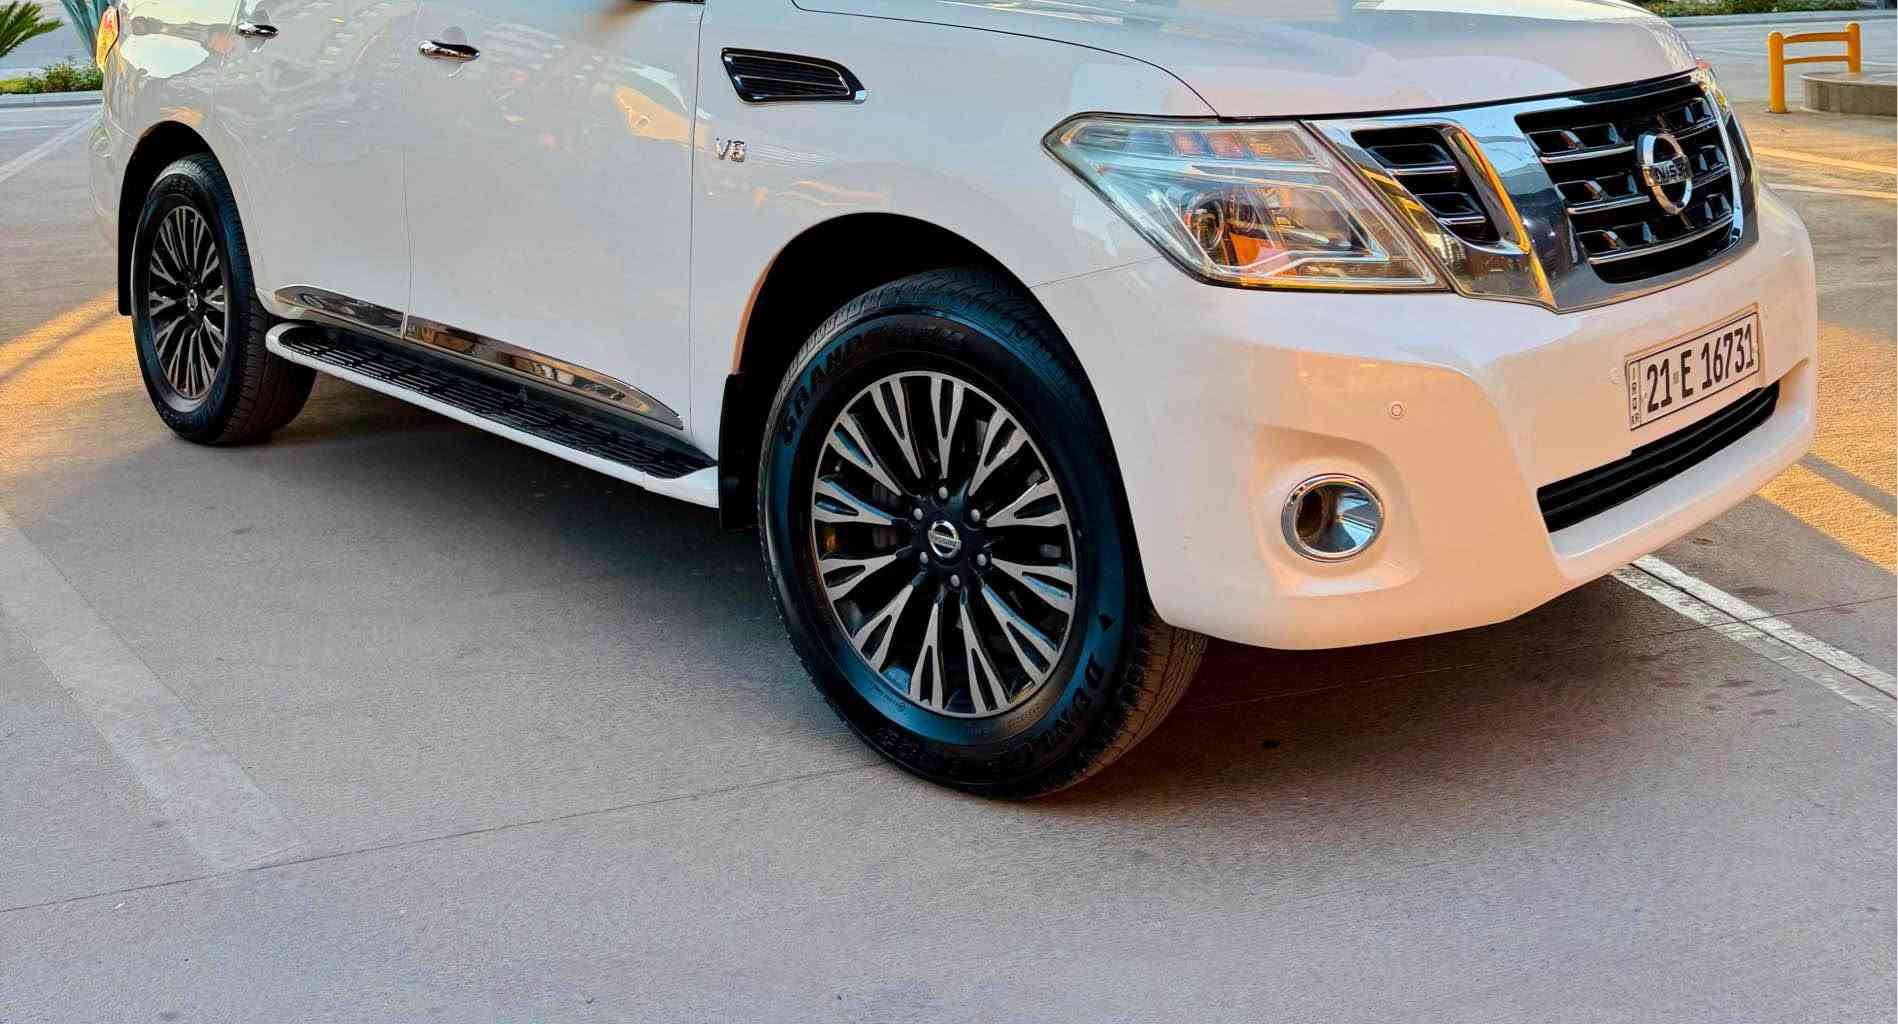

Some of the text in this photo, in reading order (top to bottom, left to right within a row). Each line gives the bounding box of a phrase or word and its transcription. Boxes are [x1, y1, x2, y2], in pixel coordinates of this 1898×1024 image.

[1647, 323, 1755, 413] 21 E 16731
